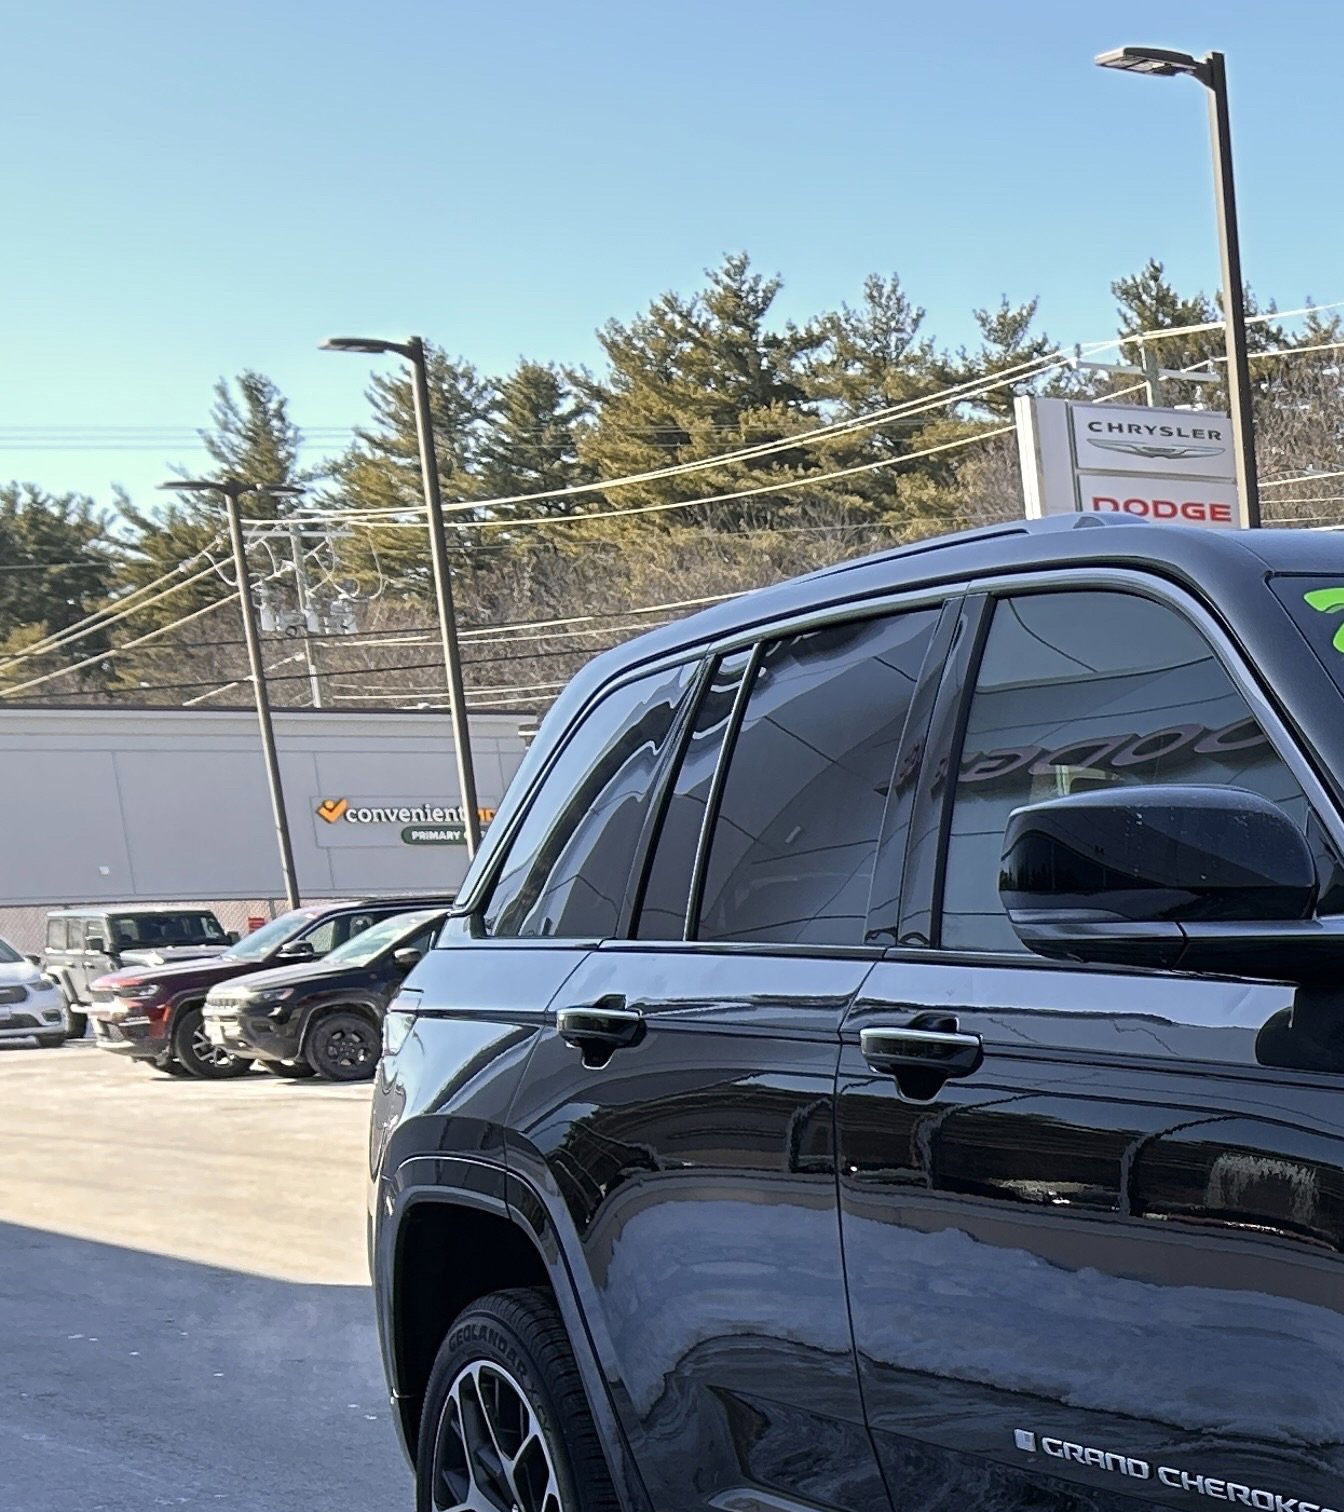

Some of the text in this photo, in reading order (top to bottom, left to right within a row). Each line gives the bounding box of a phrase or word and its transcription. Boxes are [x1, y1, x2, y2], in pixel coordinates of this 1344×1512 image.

[1088, 421, 1222, 441] CHRYSLER
[1092, 496, 1232, 522] DODGE
[411, 830, 461, 841] PRIMARY
[1041, 1436, 1150, 1480] GRAND
